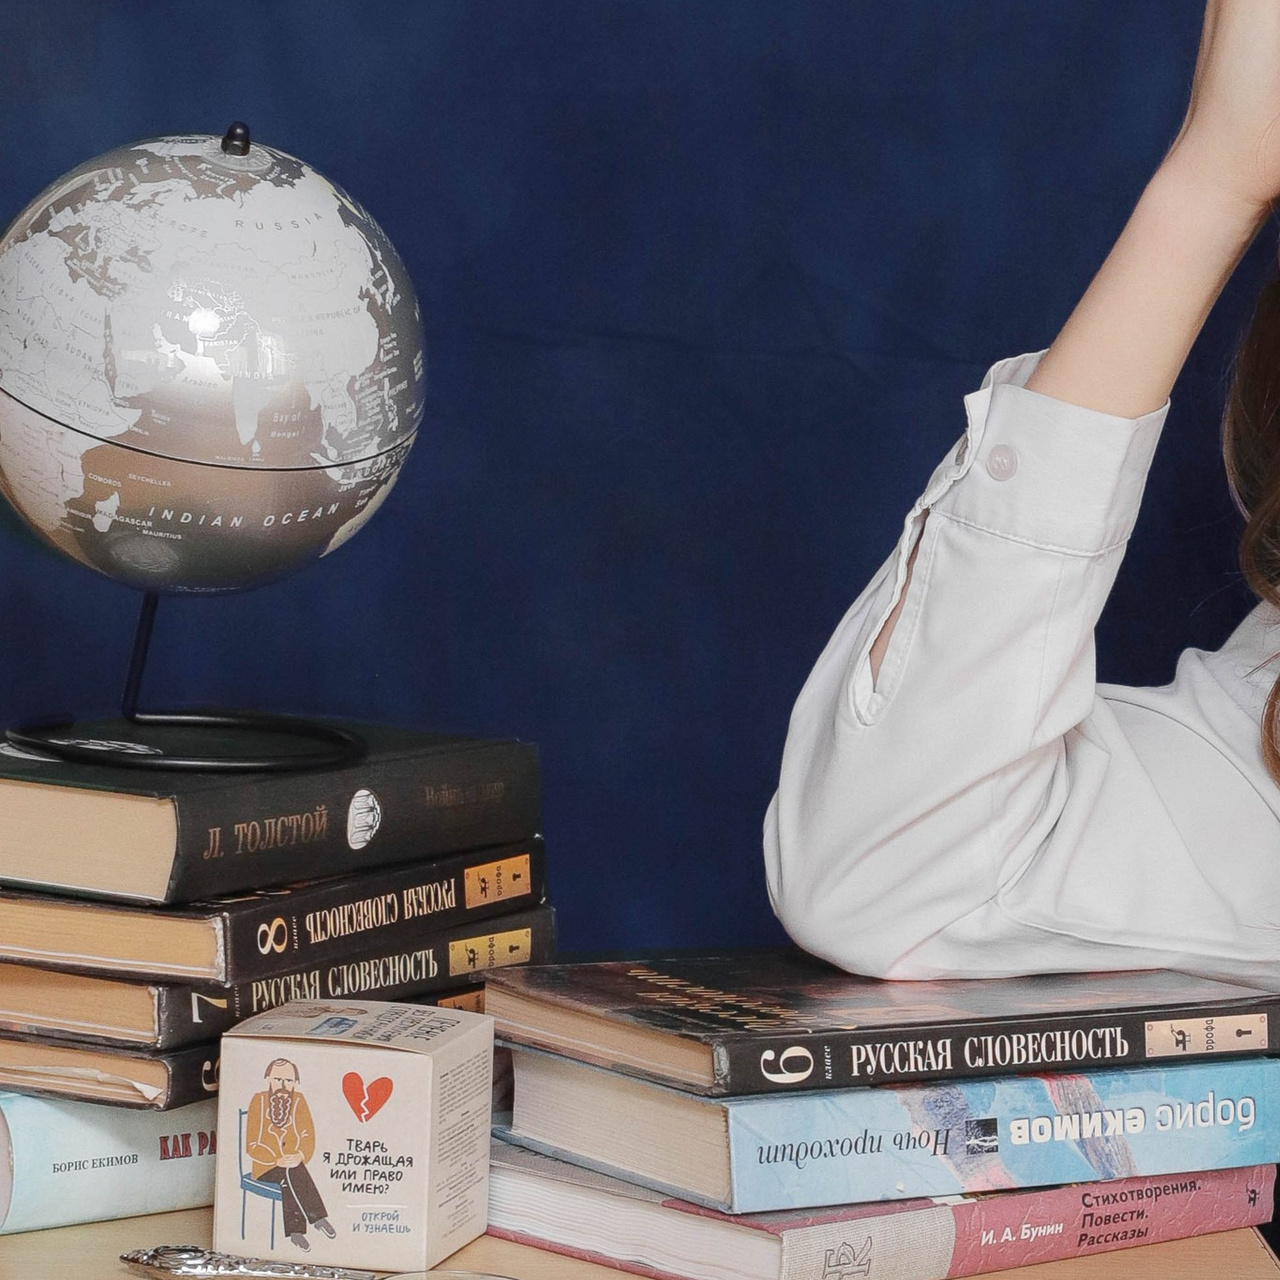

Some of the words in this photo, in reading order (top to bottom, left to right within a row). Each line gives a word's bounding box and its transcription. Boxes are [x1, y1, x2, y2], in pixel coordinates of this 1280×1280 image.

[235, 212, 323, 231] RUSSIA
[65, 342, 93, 363] SUDAN
[128, 473, 172, 487] SEYCHELLES
[97, 508, 153, 528] MADAGASCAR
[149, 506, 243, 528] INDIAN
[263, 502, 340, 528] OCEAN
[142, 528, 182, 540] MAURITIUS
[203, 827, 225, 860] Л.
[234, 804, 329, 855] ТОЛСТОЙ
[402, 878, 456, 920] РУССКАЯ
[305, 892, 398, 944] СЛОВЕСНОСТЬ
[257, 916, 288, 955] 8
[251, 969, 321, 1013] РУССКАЯ
[327, 948, 438, 997] СЛОВЕСНОСТЬ
[191, 992, 228, 1024] 7
[1205, 1018, 1214, 1052] дрофа
[850, 1038, 954, 1077] РУССКАЯ
[963, 1026, 1130, 1069] СЛОВЕСНОСТЬ
[760, 1045, 815, 1085] 6
[824, 1045, 833, 1080] класс
[1009, 1105, 1146, 1147] екимов
[1155, 1096, 1257, 1133] борис
[159, 1132, 193, 1161] КАК
[346, 1138, 388, 1153] ТВАРЬ
[757, 1130, 883, 1170] проходит
[891, 1127, 952, 1158] Ночь
[52, 1159, 89, 1174] БОРИС
[91, 1153, 139, 1170] ЕКИМОВ
[323, 1152, 331, 1164] Я
[335, 1152, 414, 1168] ДРОЖАЩАЯ
[330, 1168, 357, 1180] ИЛИ
[363, 1169, 403, 1182] ПРАВО
[342, 1182, 390, 1195] ИМЕЮ?
[1081, 1180, 1202, 1209] Стихотворения.
[352, 1223, 361, 1233] И
[364, 1223, 412, 1234] УЗНАЕШЬ
[361, 1210, 400, 1222] ОТКРОЙ
[1081, 1208, 1149, 1229] Повести.
[980, 1230, 997, 1247] И.
[1001, 1227, 1016, 1243] А.
[1020, 1221, 1064, 1239] Бунин
[1077, 1226, 1149, 1248] Рассказы
